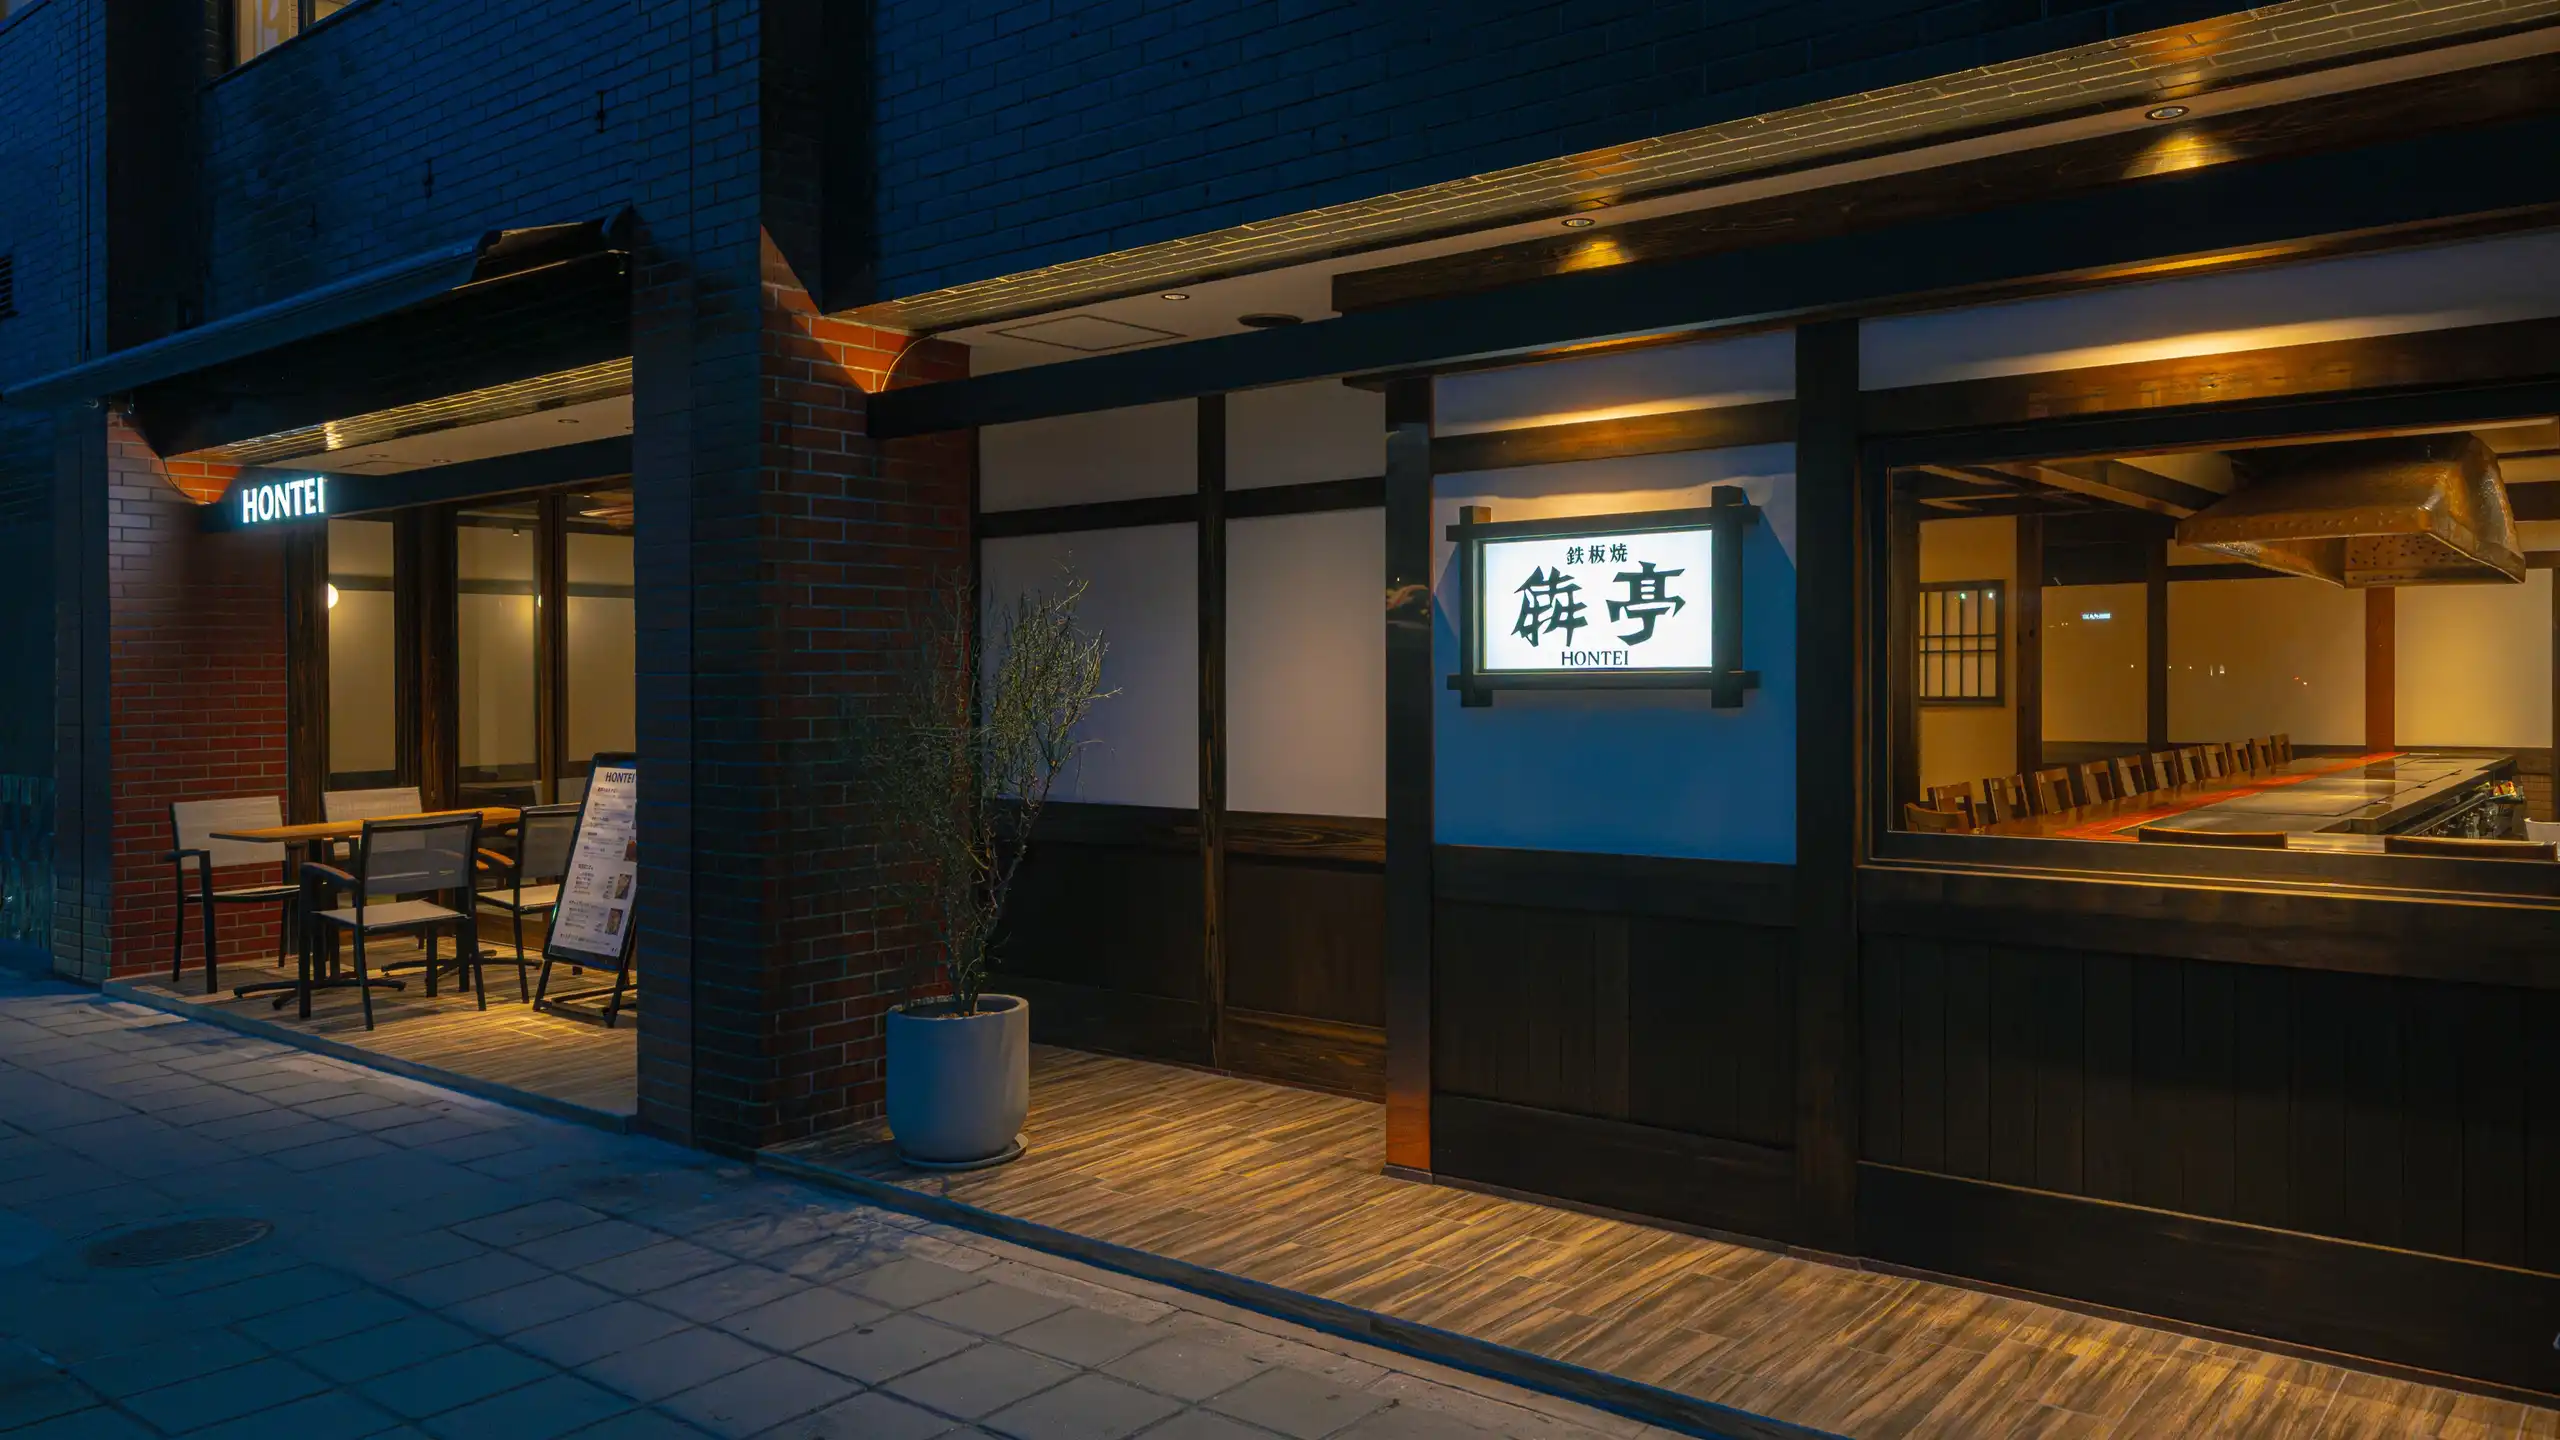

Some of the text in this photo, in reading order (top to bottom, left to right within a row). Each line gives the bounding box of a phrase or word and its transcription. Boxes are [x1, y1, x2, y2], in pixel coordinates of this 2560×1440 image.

[243, 477, 325, 523] HONTEI
[1566, 543, 1628, 565] 鉄板焼
[1561, 650, 1629, 666] HONTEI
[605, 771, 635, 784] HONTEI
